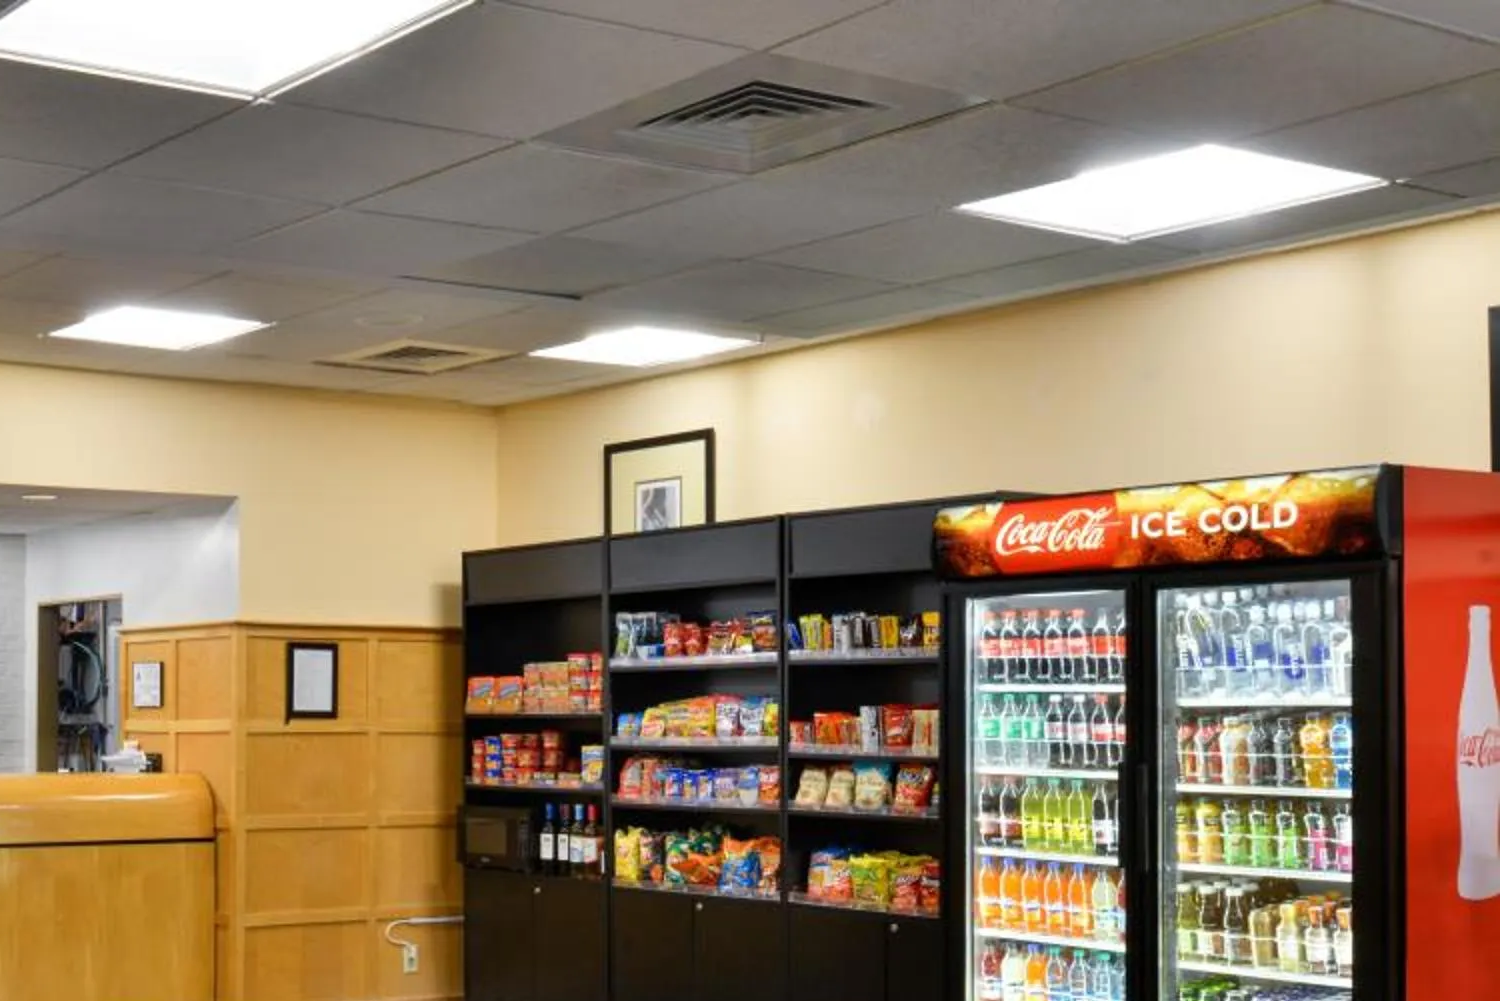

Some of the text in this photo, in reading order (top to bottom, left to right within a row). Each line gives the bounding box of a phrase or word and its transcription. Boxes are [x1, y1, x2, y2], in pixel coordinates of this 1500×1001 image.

[995, 506, 1122, 556] Coca-Cola
[1131, 500, 1298, 539] ICE COLD
